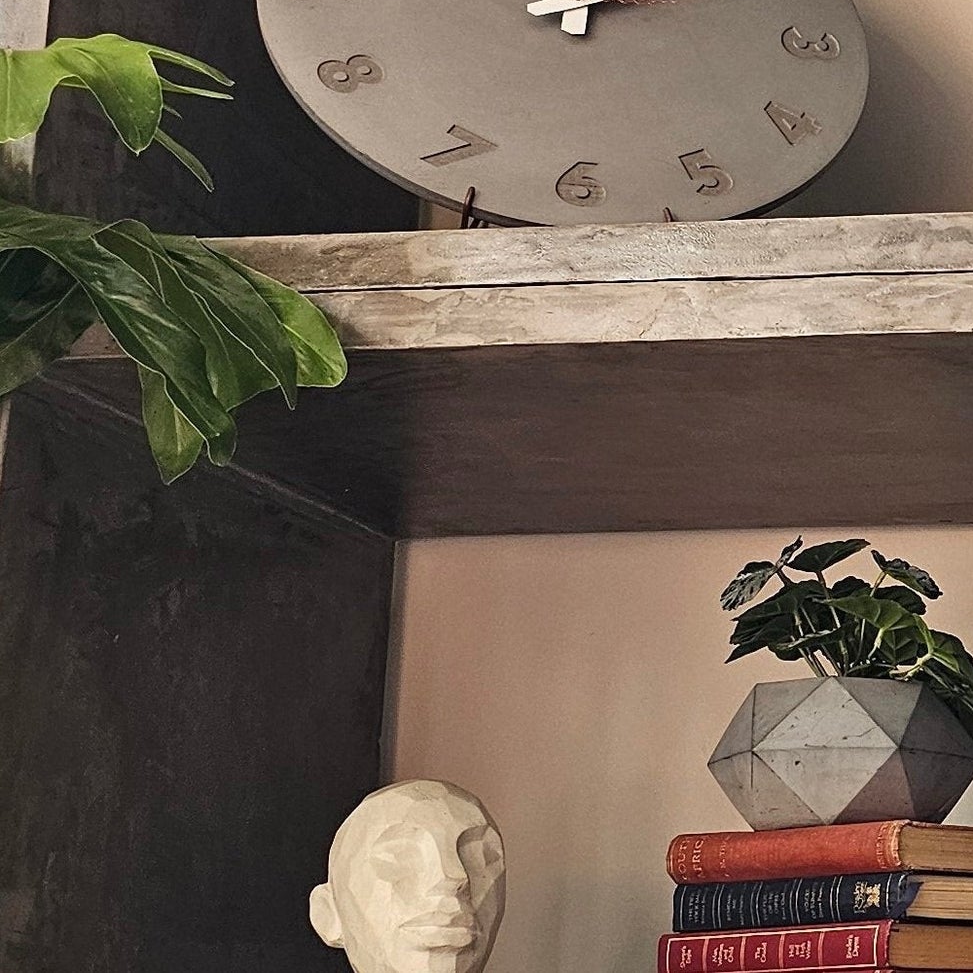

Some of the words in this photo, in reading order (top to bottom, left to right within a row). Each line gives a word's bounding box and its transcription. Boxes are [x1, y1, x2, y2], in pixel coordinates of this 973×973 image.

[780, 26, 842, 61] 3
[316, 53, 385, 94] 8
[419, 123, 500, 168] 7
[763, 100, 823, 147] 4
[555, 160, 607, 207] 6
[678, 147, 735, 197] 5
